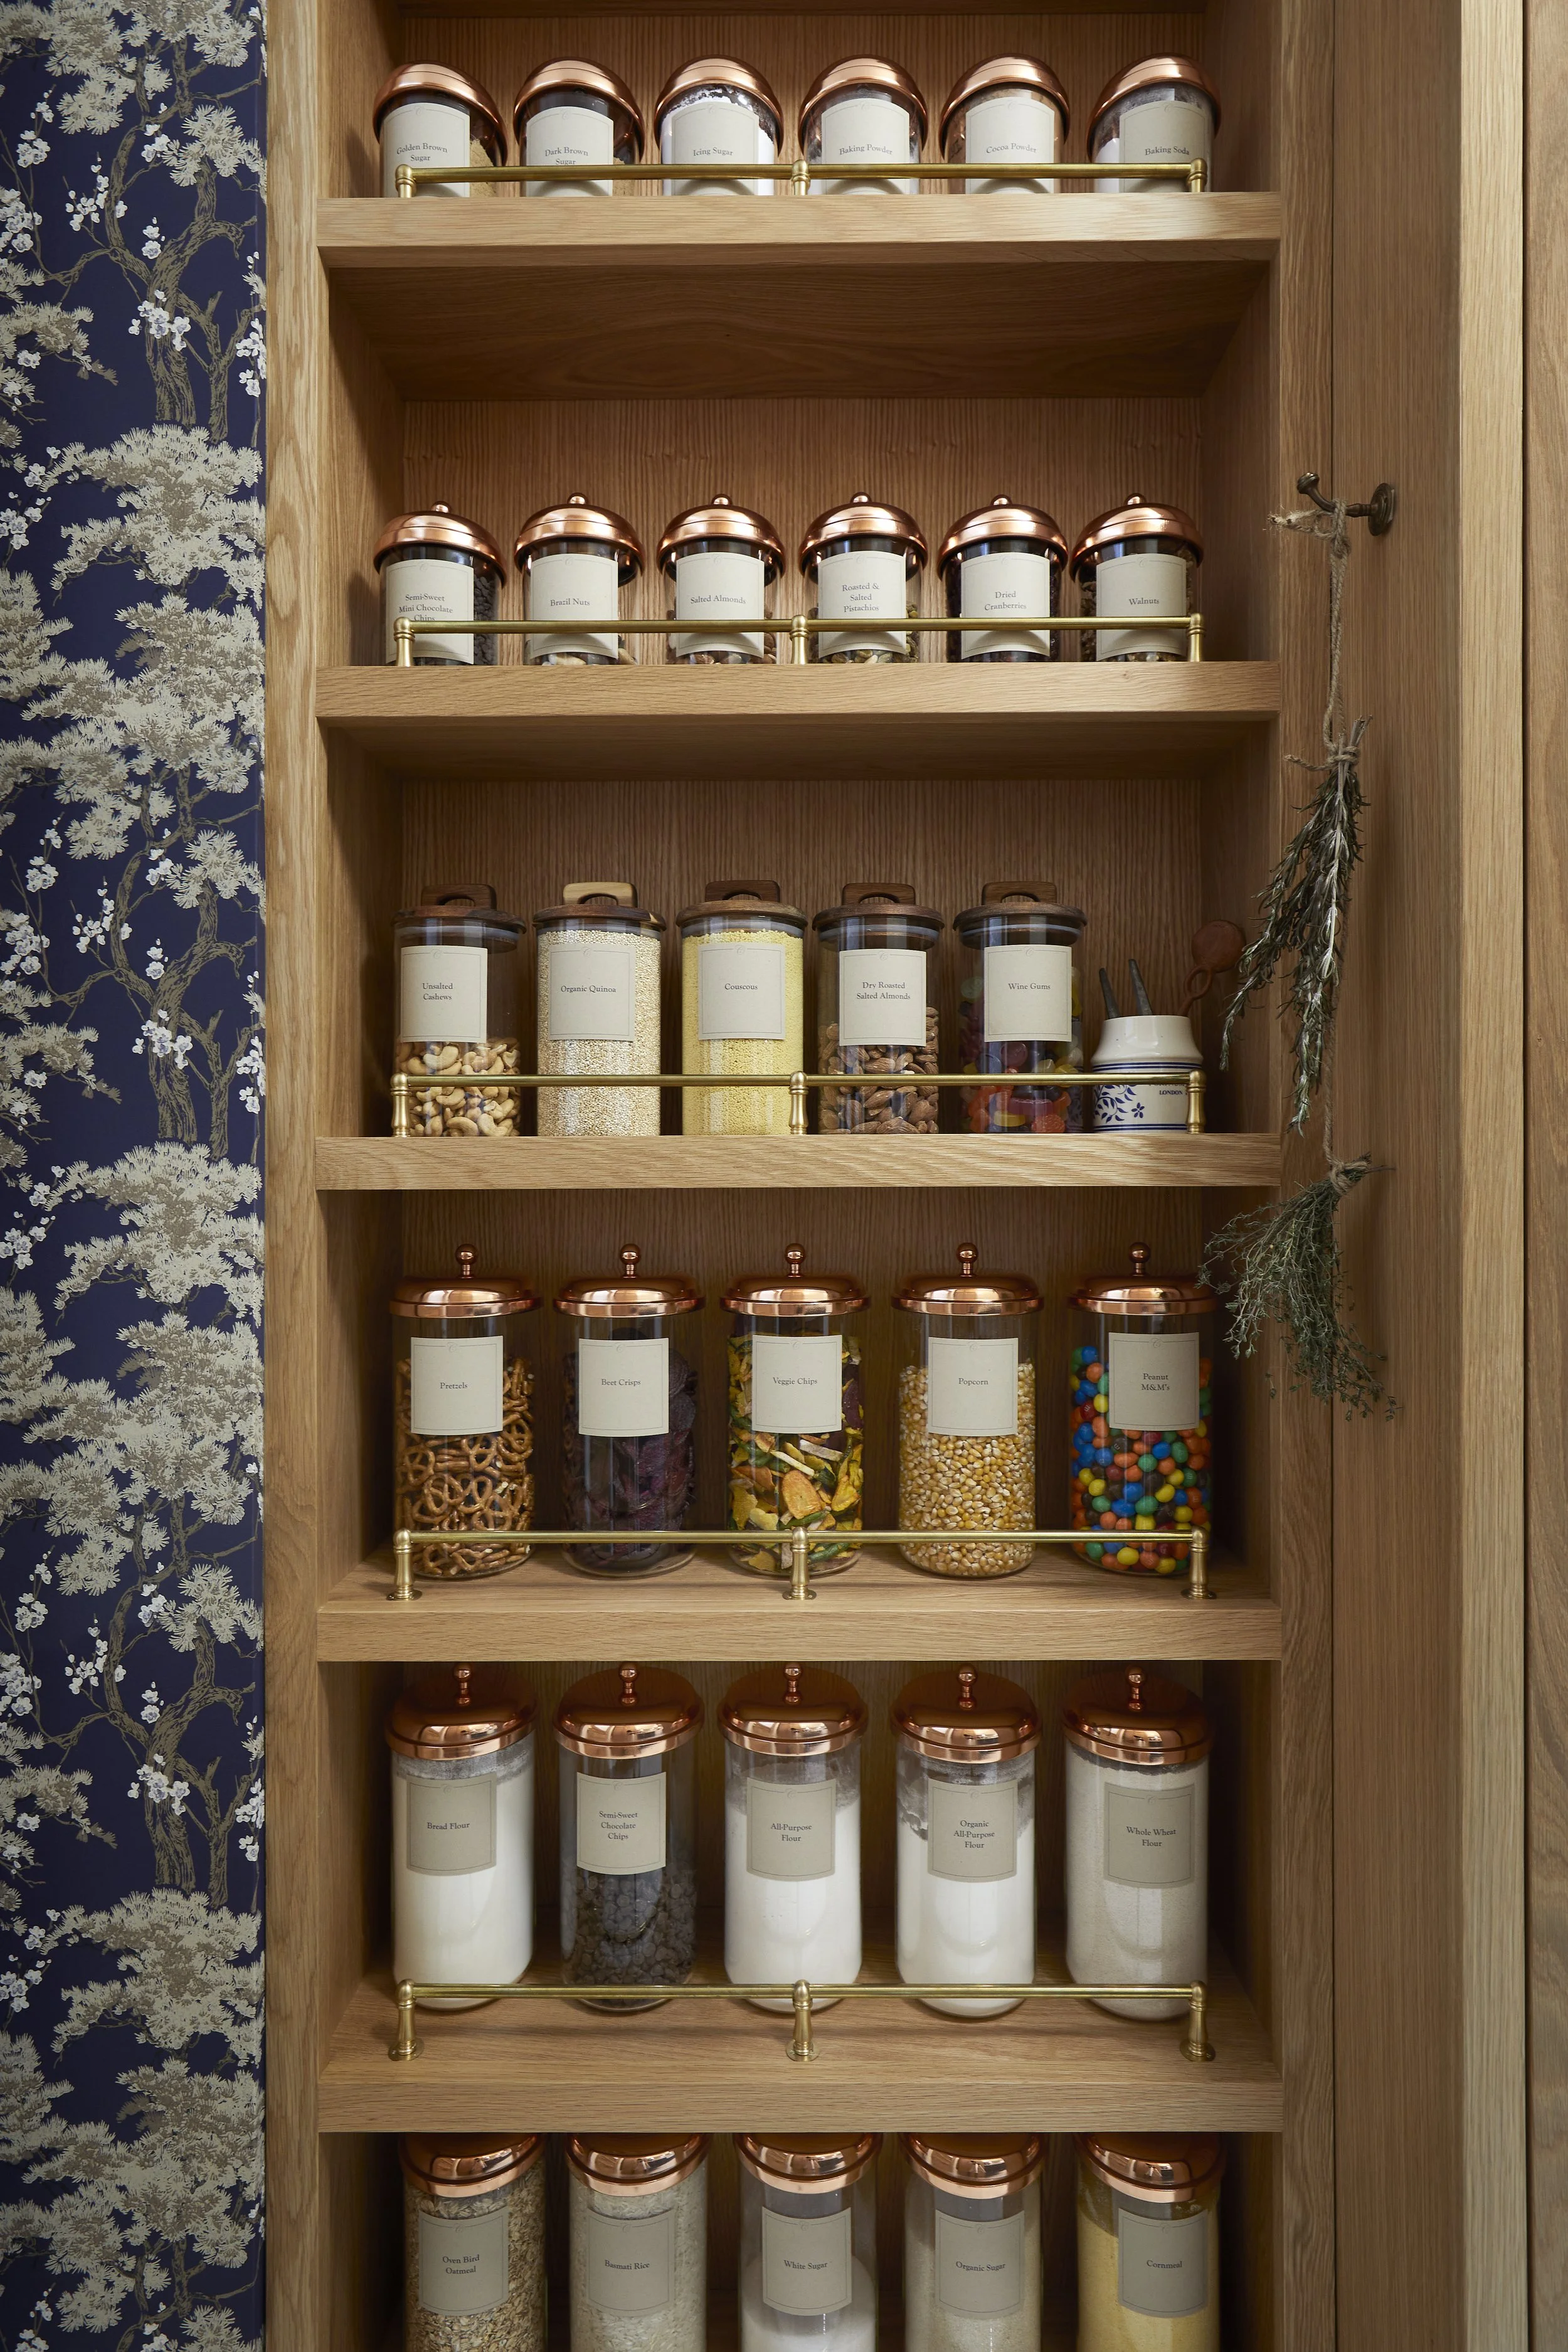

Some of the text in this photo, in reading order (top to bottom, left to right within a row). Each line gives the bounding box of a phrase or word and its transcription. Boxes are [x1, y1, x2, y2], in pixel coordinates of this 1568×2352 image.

[396, 142, 448, 154] Golden Brown
[564, 147, 588, 156] Brown
[712, 147, 733, 156] Sugar
[839, 144, 893, 155] Baking Powder
[986, 143, 1037, 154] Cocoa Powder
[1145, 146, 1190, 155] Baking Soda
[842, 583, 870, 592] Roasted
[405, 593, 445, 601] Semi-Sweet
[691, 595, 746, 605] Salted Almonds
[850, 593, 872, 601] Salted
[1129, 597, 1160, 605] Walnuts
[550, 598, 590, 607] Brazil Nuts
[984, 602, 1027, 610] Cranberries
[416, 604, 453, 613] Chocolate
[844, 604, 879, 613] Pistachios
[561, 985, 617, 993] Organic Quinoa
[862, 982, 876, 990] Dry
[618, 1379, 641, 1387] Crisps
[773, 1377, 818, 1385] Veggie Chips
[958, 1377, 988, 1385] Popcorn
[599, 1811, 638, 1819] Semi-Sweet
[426, 1822, 447, 1830] Bread
[770, 1823, 813, 1831] All-Purpose
[960, 1820, 989, 1828] Organic
[953, 1831, 995, 1839] All-Purpose
[1126, 1826, 1152, 1836] Whole
[608, 1832, 628, 1840] Chips
[1142, 1839, 1162, 1847] Flour
[464, 2254, 480, 2263] Bird
[605, 2259, 632, 2270] Basmati
[783, 2260, 828, 2270] White Sugar
[955, 2260, 1005, 2271] Organic Sugar
[1147, 2260, 1182, 2269] Cornmeal
[446, 2265, 476, 2274] Oatmeal
